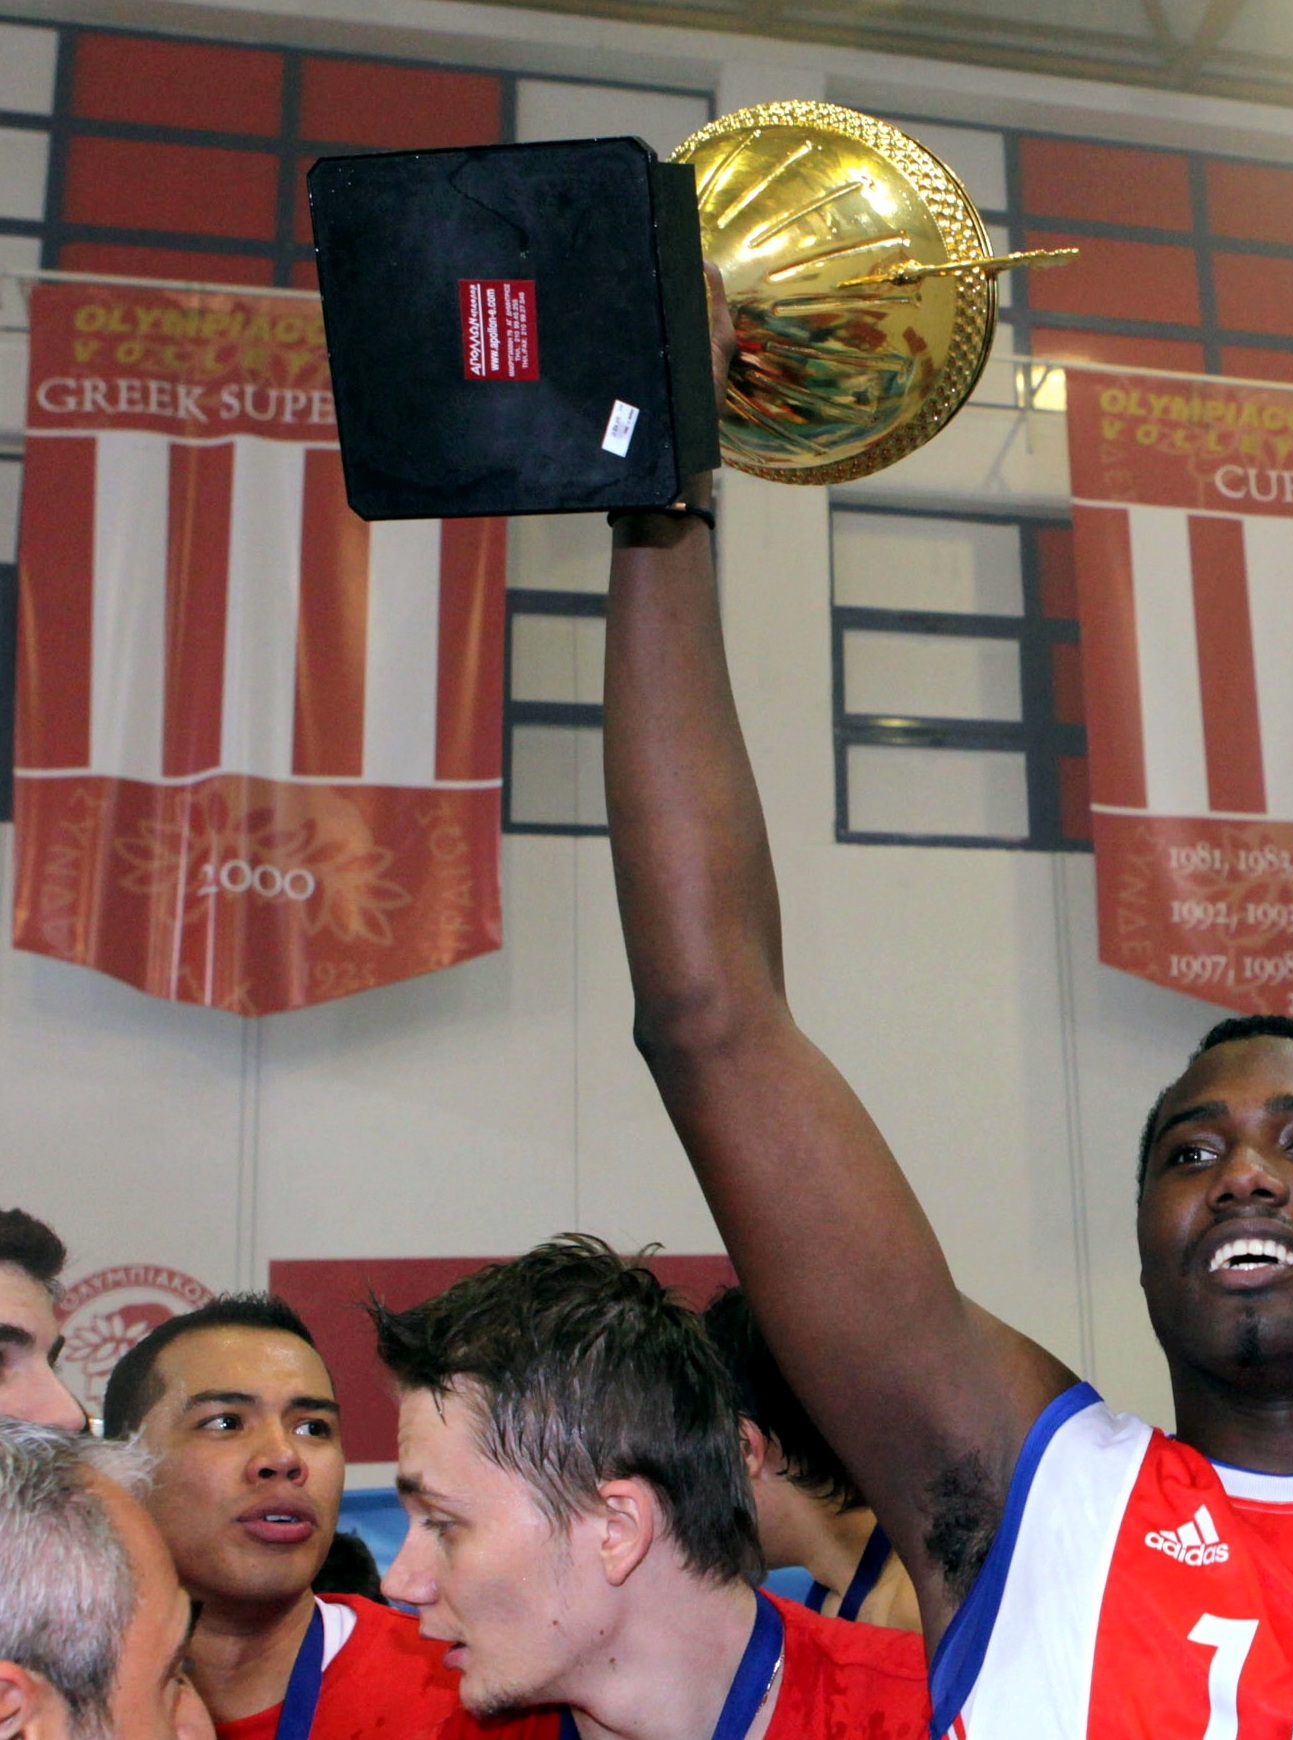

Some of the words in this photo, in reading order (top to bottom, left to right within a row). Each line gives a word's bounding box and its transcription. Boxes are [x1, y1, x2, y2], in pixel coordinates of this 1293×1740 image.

[487, 288, 501, 371] www.apollon-e.com
[72, 339, 314, 371] VOLLEY
[37, 376, 209, 424] GREEK
[219, 383, 337, 425] SUPE
[1169, 841, 1229, 880] 1981,
[196, 858, 316, 901] 2000
[1171, 901, 1239, 934] 1992,
[1170, 955, 1236, 986] 1997,
[1144, 1531, 1229, 1566] adidas
